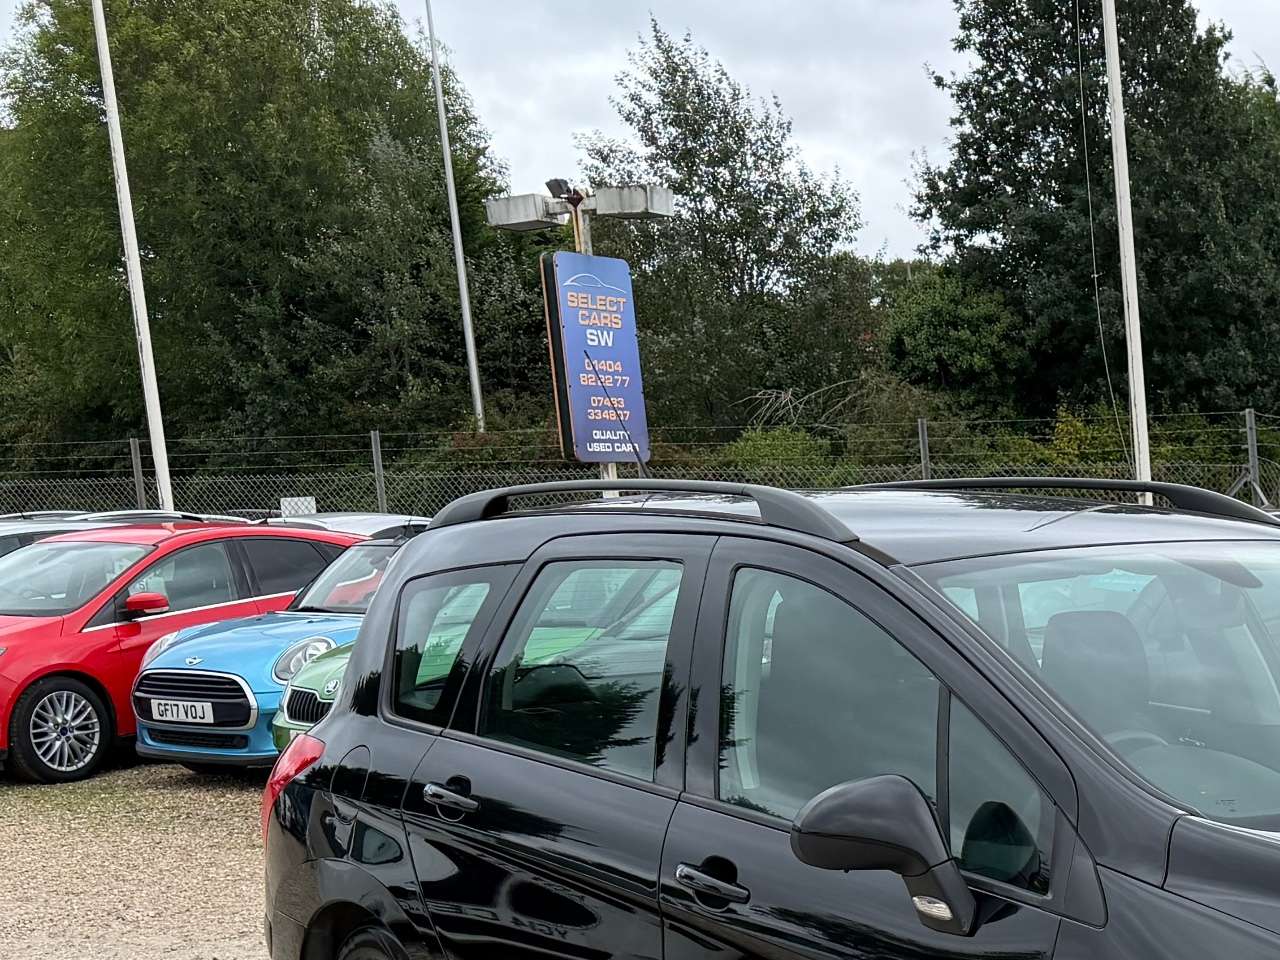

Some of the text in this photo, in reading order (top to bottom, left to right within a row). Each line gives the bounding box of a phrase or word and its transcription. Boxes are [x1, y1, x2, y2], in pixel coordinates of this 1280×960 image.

[567, 291, 627, 313] SELECT
[578, 309, 622, 329] CARS
[586, 328, 614, 347] SW
[584, 358, 623, 373] 01404
[586, 442, 613, 452] USED
[157, 702, 180, 719] GF17
